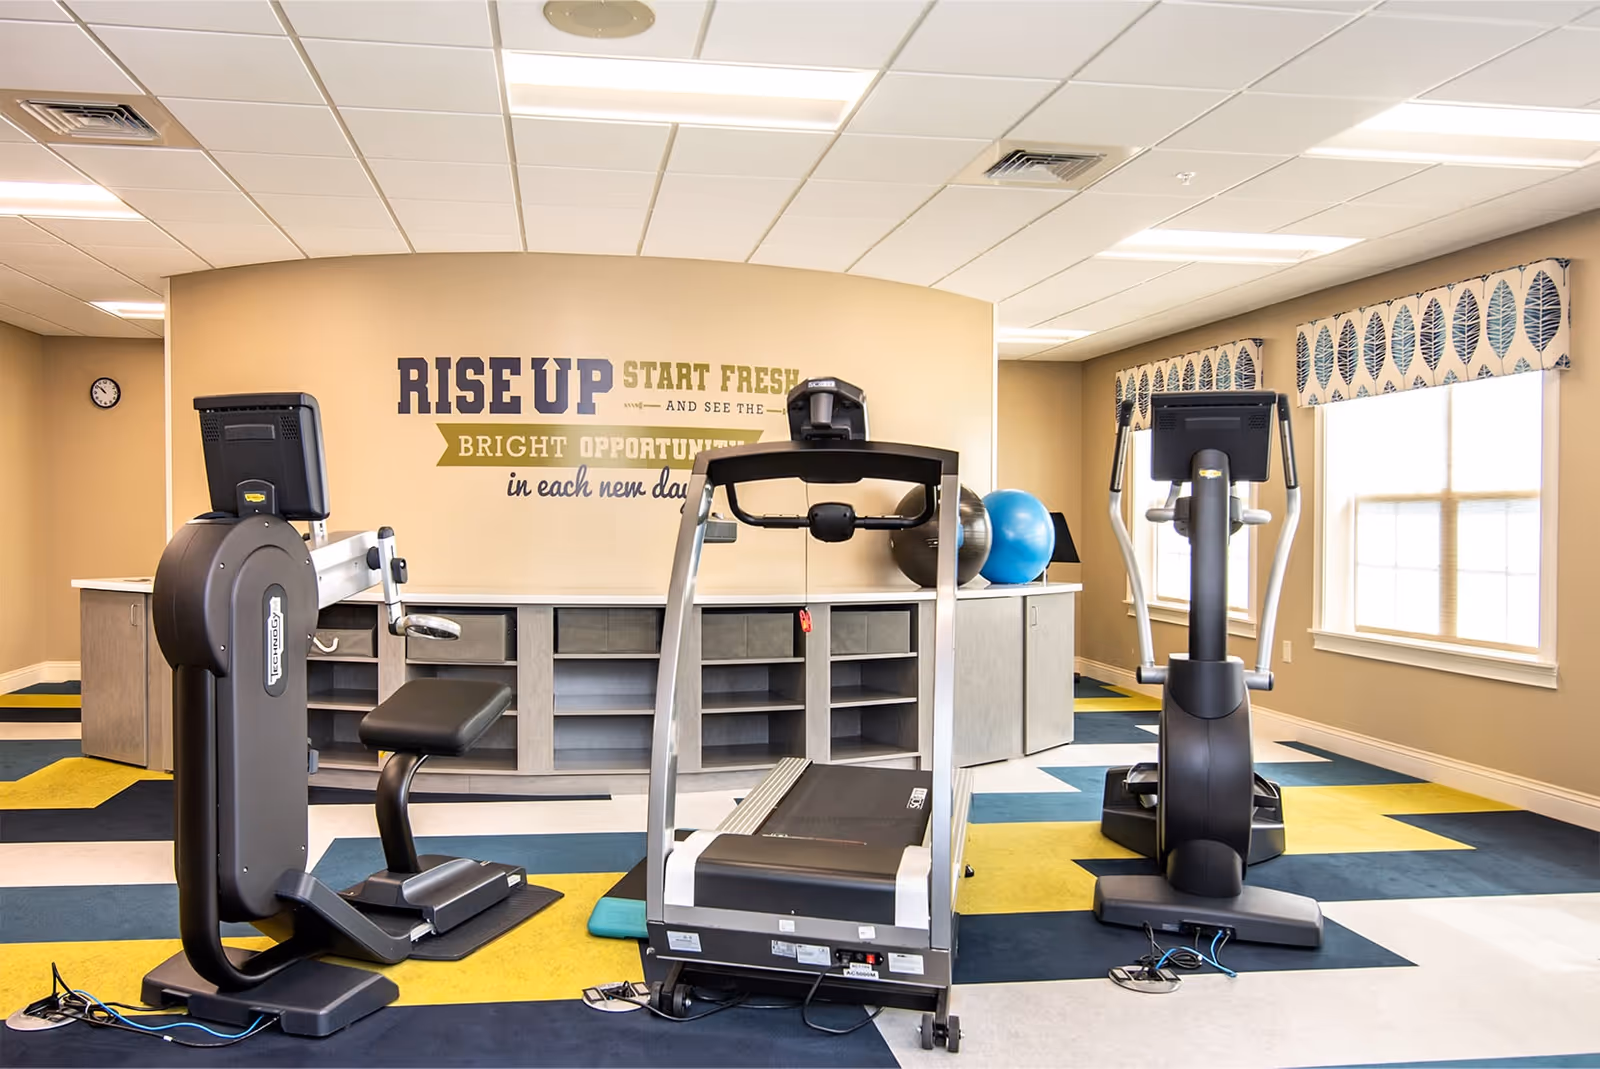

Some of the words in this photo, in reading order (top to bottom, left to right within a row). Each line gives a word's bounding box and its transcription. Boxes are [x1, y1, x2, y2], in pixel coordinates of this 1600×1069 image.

[398, 357, 521, 414] RISE
[532, 357, 614, 414] UP
[623, 360, 710, 391] START
[721, 364, 799, 395] FRESH
[666, 401, 697, 413] AND
[704, 402, 731, 414] SEE
[736, 403, 764, 415] THE
[459, 435, 567, 458] BRIGHT
[580, 437, 745, 461] OPPORTUNI
[507, 472, 532, 498] in
[538, 464, 592, 499] each
[599, 477, 646, 499] new
